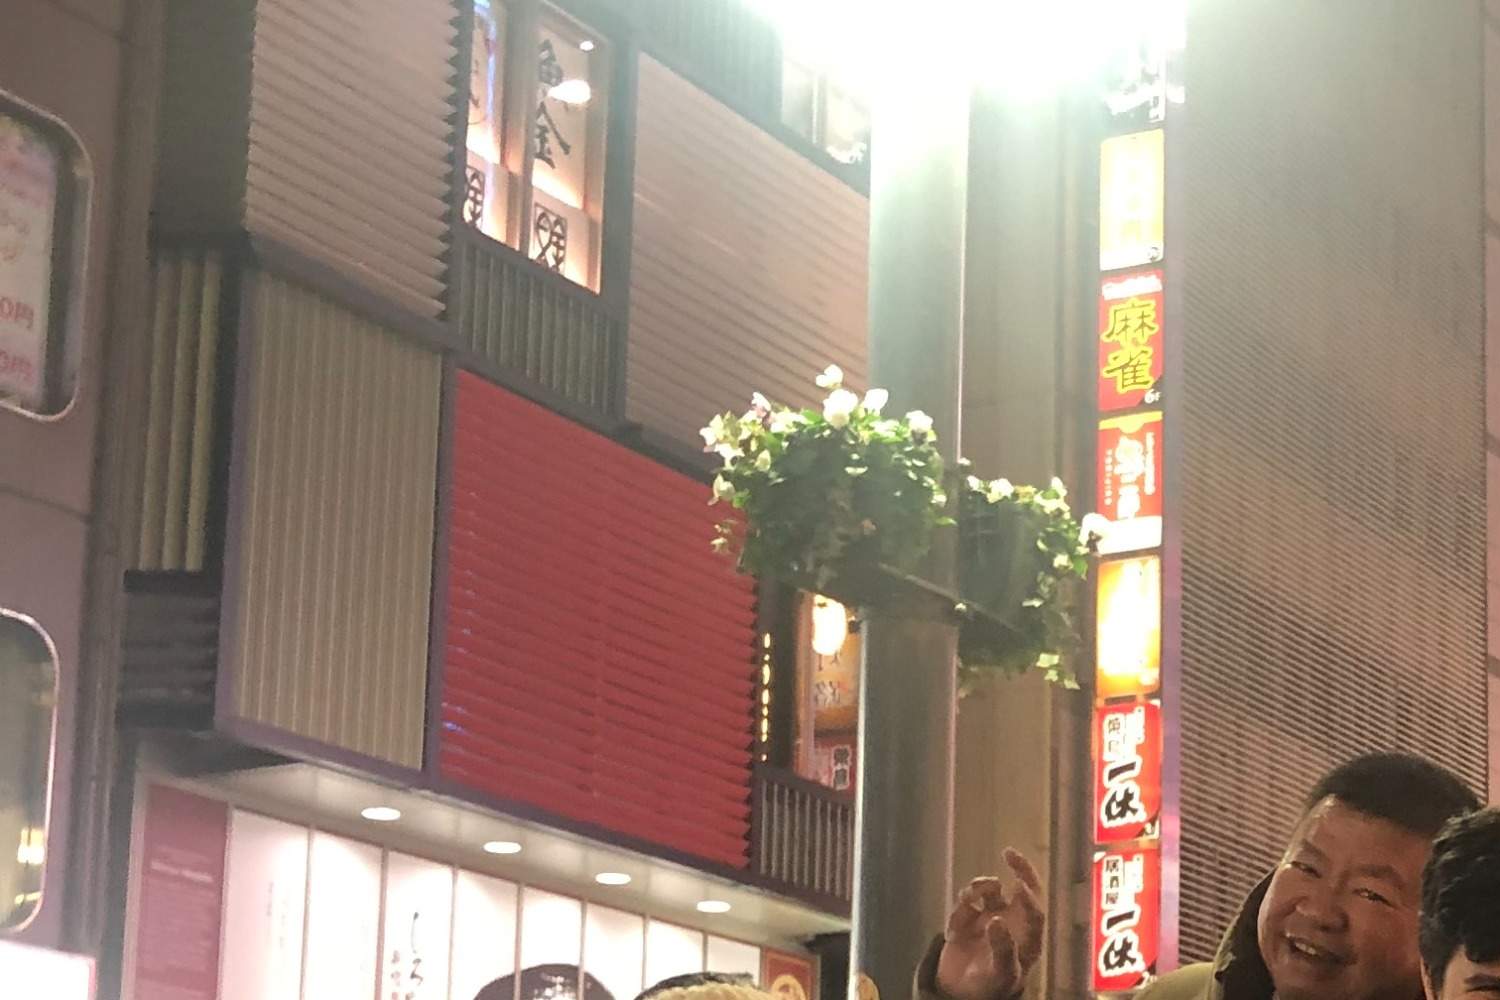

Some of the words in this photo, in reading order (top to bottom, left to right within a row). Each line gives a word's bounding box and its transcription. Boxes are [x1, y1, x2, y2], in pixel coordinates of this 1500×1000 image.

[1105, 302, 1158, 391] 麻雀
[1105, 761, 1139, 823] 一休
[1103, 909, 1138, 971] 一休
